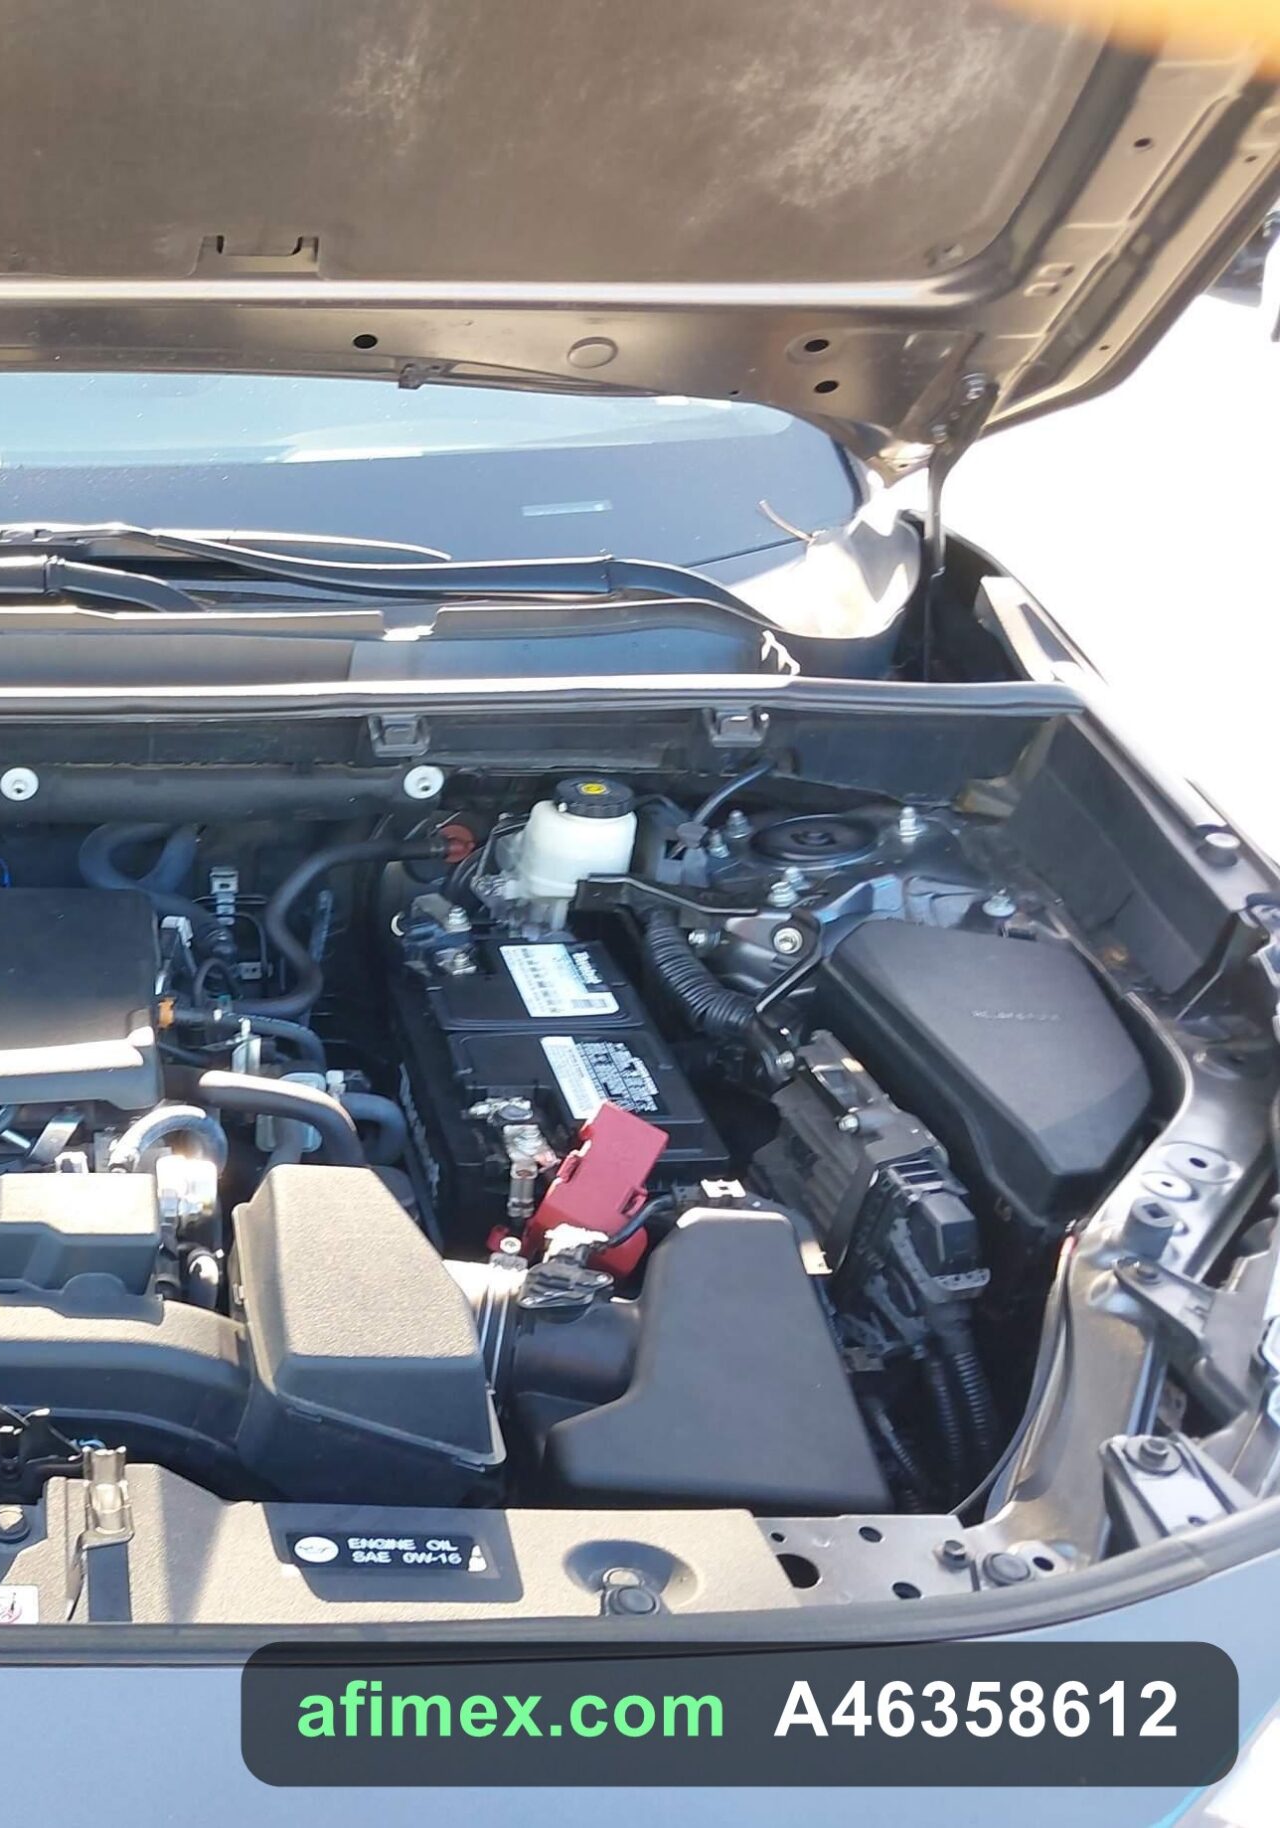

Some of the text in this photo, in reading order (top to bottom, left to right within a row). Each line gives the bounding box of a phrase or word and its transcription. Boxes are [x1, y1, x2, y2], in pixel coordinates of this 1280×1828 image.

[347, 1537, 458, 1551] ENGINE OIL
[351, 1551, 463, 1565] SAE 0W-16
